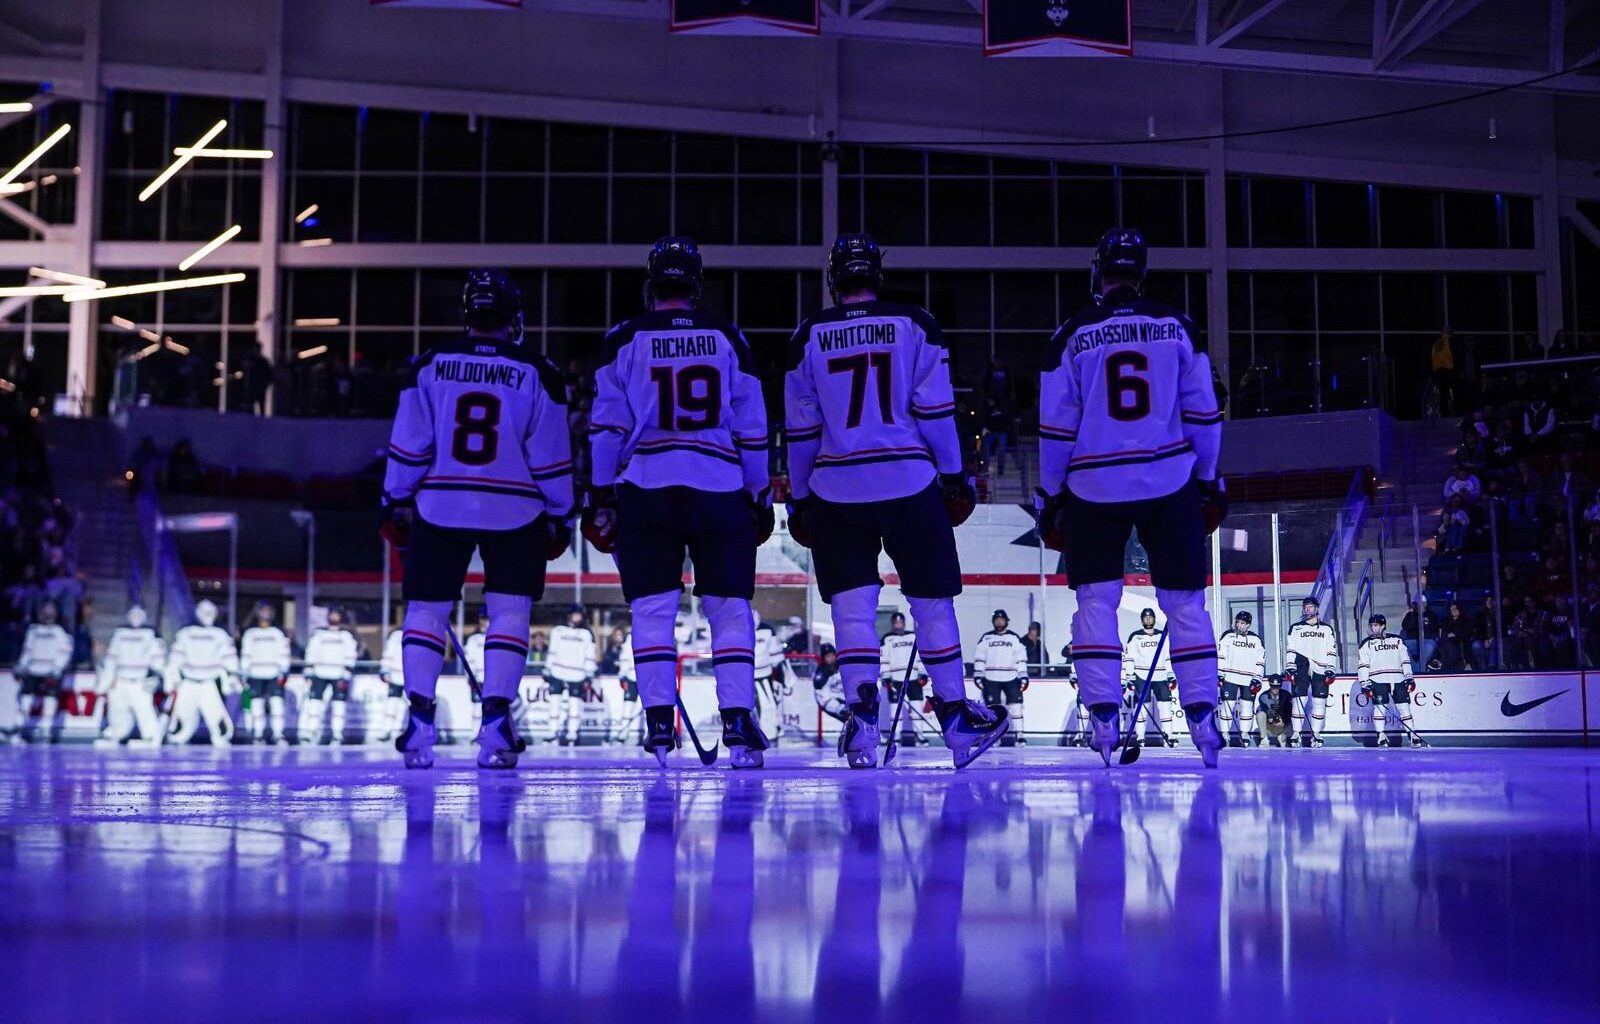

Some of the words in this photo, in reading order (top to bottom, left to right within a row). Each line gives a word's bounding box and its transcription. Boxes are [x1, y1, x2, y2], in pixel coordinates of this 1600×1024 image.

[651, 335, 717, 359] RICHARD
[818, 323, 896, 352] WHITCOMB
[1139, 323, 1183, 343] NYBERG
[435, 360, 527, 391] MULDOWNEY
[827, 351, 895, 429] 71
[1105, 350, 1151, 422] 6
[650, 364, 721, 431] 19
[451, 391, 501, 465] 8
[1300, 630, 1325, 639] UCONN
